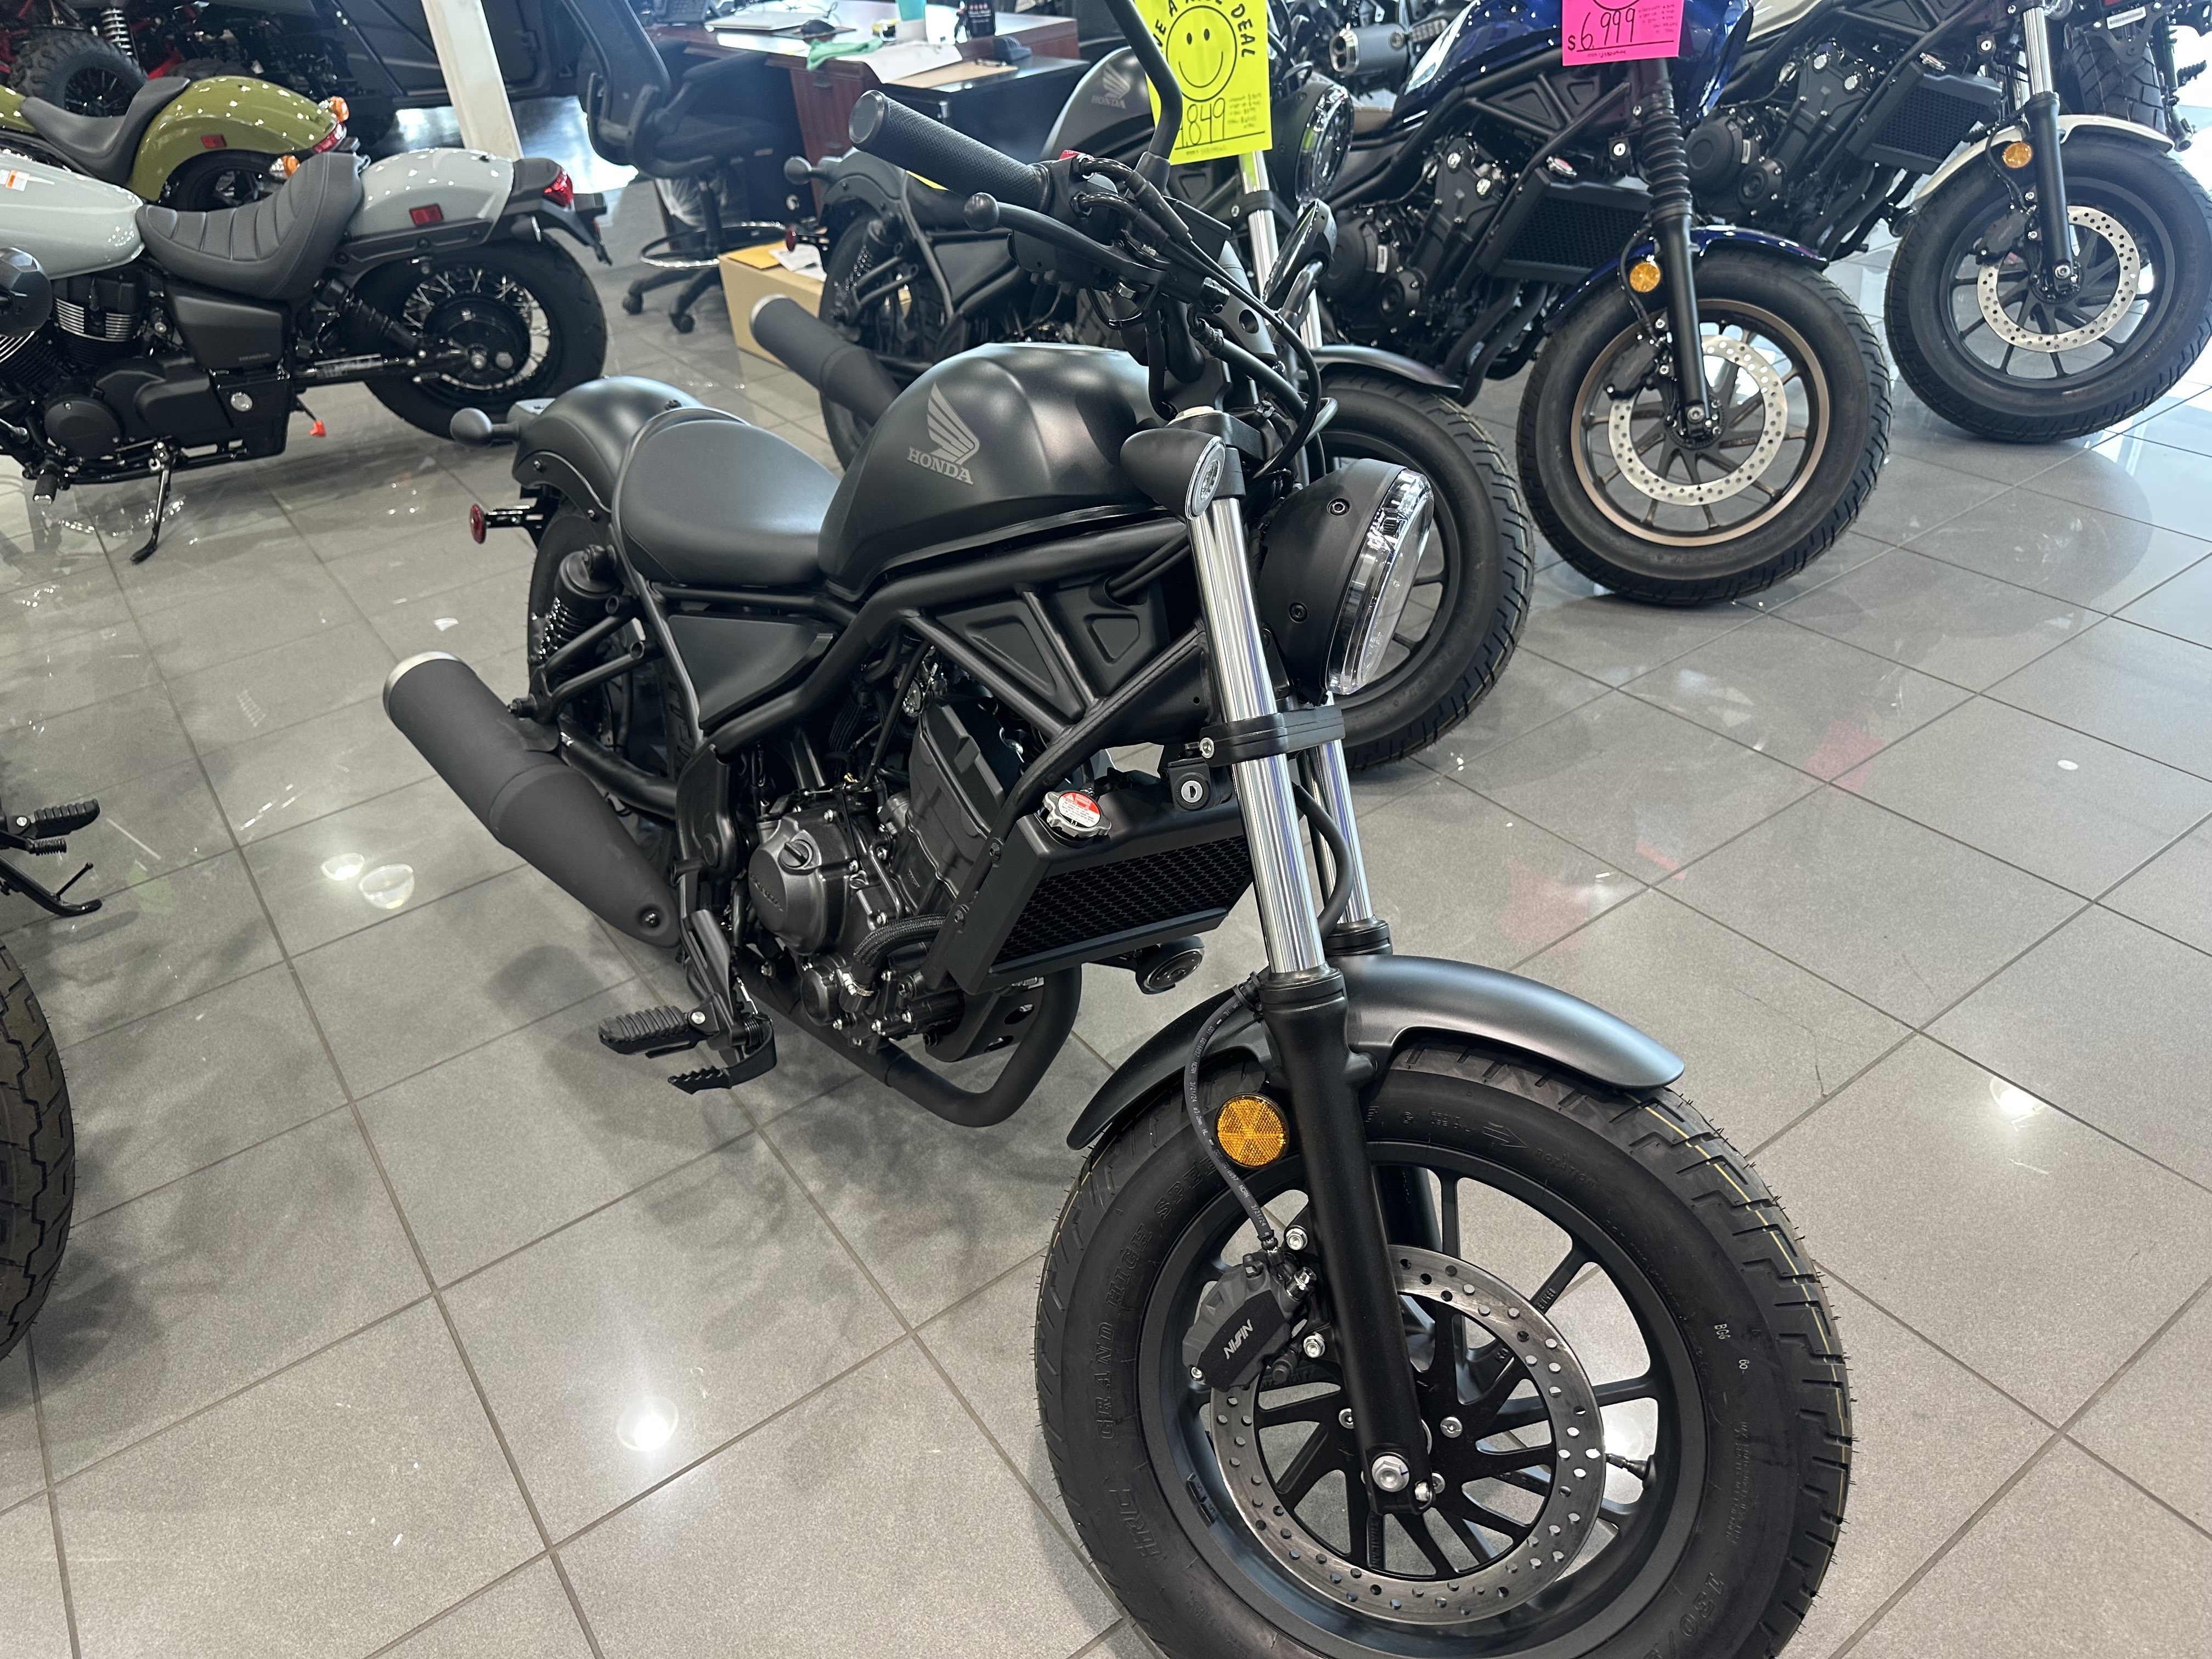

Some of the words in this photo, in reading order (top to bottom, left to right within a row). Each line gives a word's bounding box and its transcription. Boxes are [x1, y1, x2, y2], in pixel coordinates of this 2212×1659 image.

[1231, 3, 1255, 57] DEAL
[907, 445, 974, 486] HONDA
[1251, 1204, 1267, 1227] 3/21/24
[1094, 1321, 1115, 1440] GRAND
[1105, 1223, 1153, 1307] HIGH
